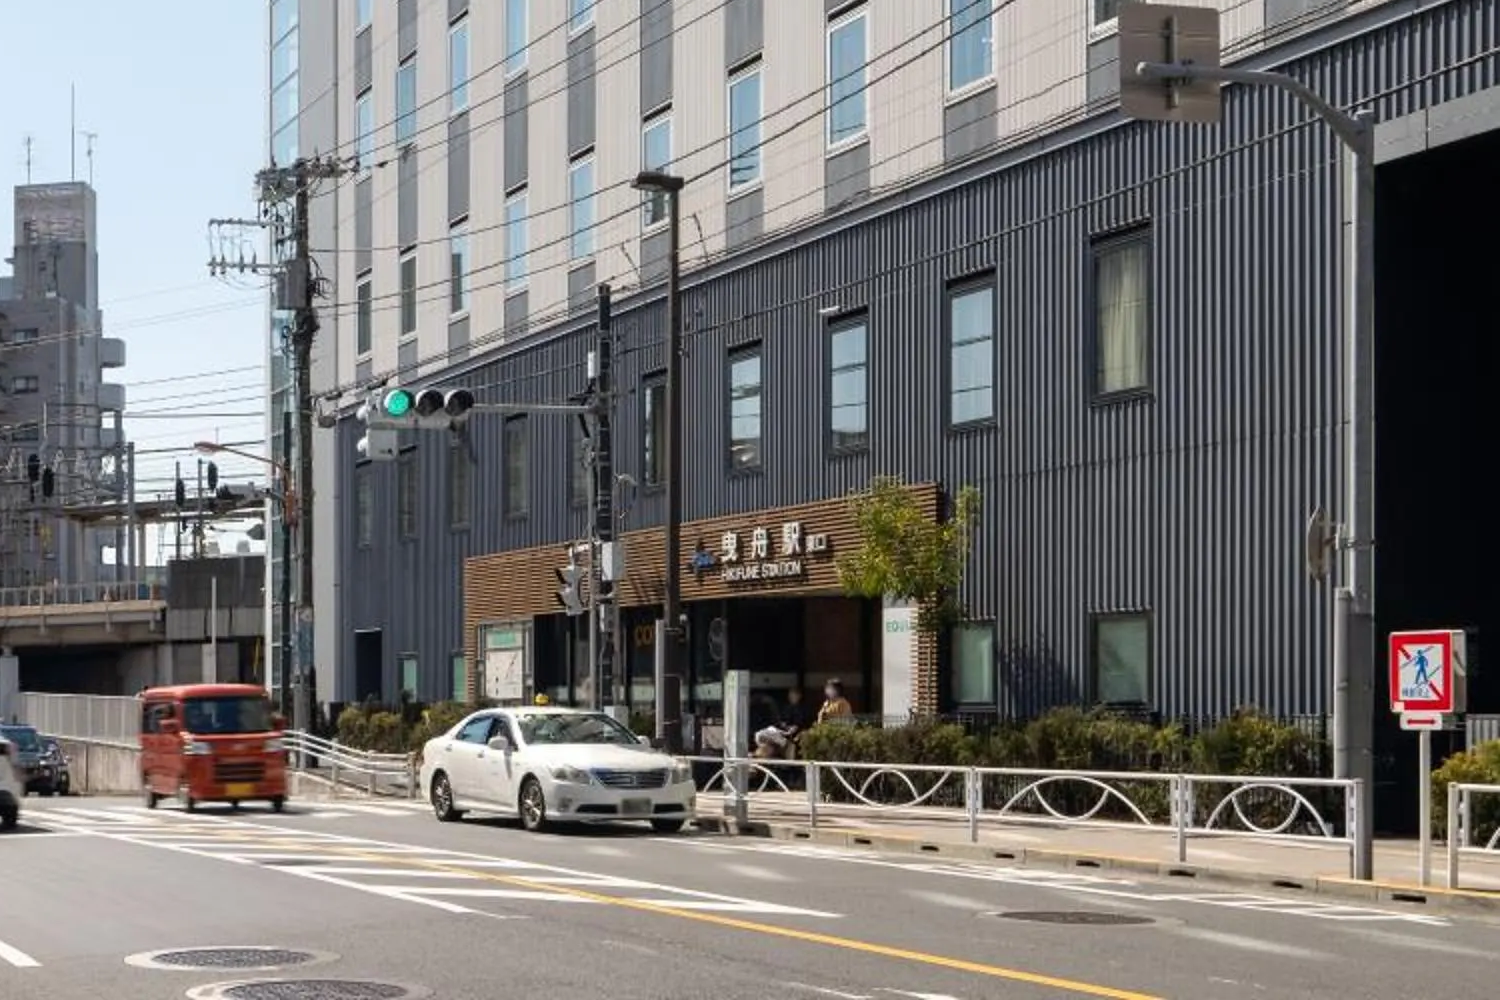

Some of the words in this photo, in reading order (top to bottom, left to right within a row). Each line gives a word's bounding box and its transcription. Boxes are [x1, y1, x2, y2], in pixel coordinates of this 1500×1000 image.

[721, 521, 801, 563] 曳舟駅
[761, 559, 801, 579] STATION
